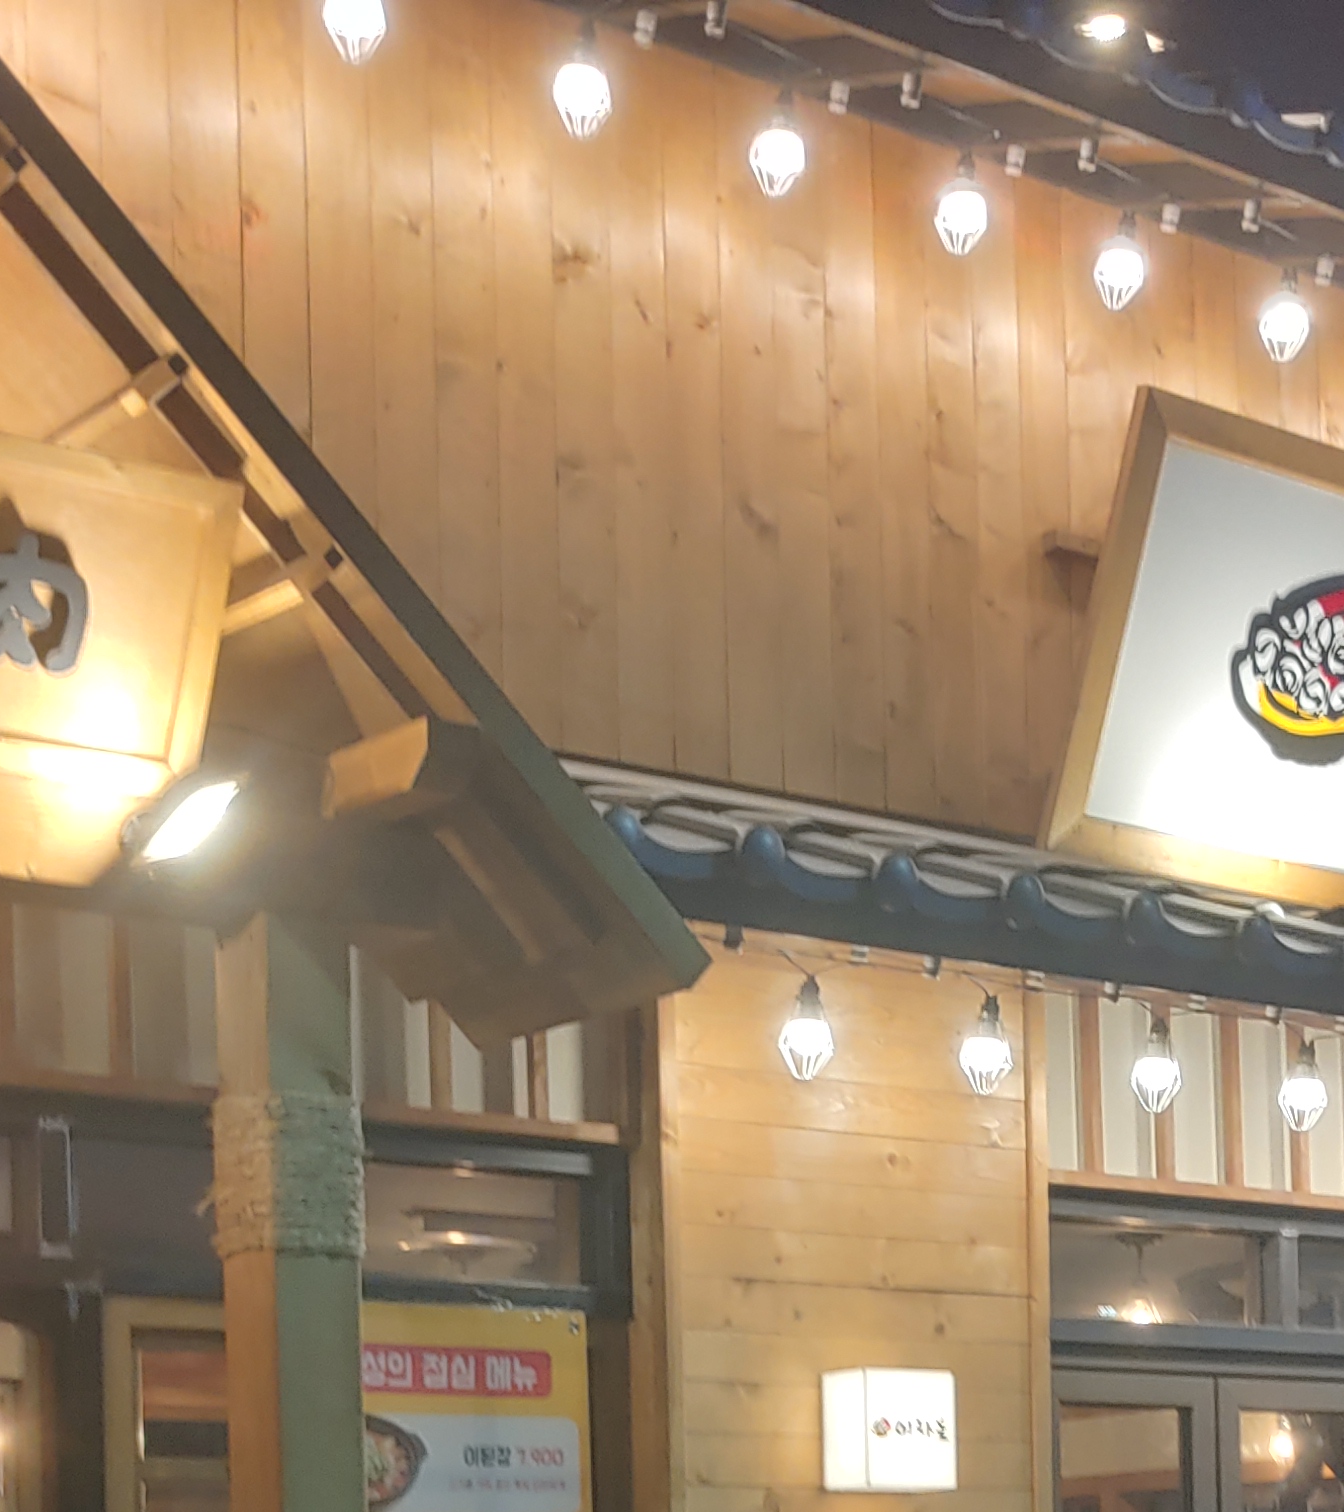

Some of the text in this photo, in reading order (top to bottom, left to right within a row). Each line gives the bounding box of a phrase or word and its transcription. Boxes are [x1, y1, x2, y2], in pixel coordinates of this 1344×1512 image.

[422, 1352, 476, 1390] 점심
[485, 1355, 539, 1392] 메뉴
[894, 1418, 950, 1442] 이차돌
